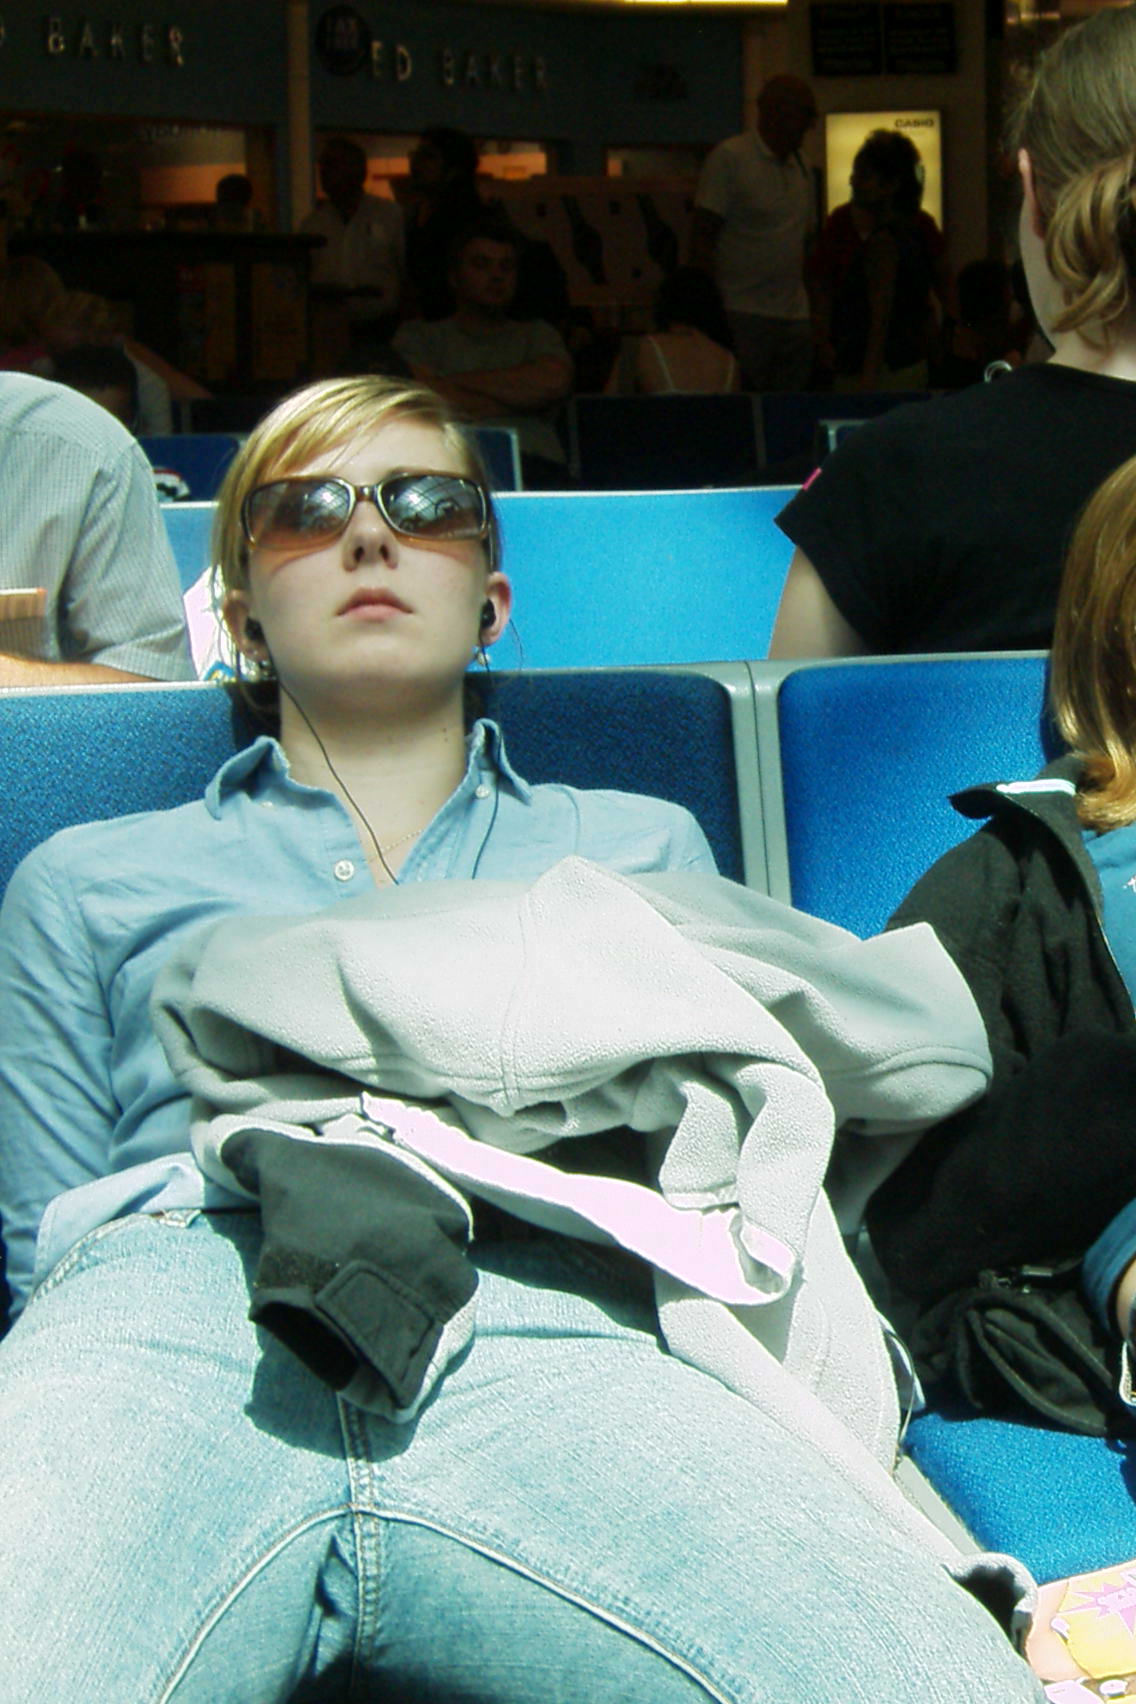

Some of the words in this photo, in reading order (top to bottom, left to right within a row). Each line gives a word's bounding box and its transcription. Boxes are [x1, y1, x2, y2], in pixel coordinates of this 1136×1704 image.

[49, 17, 185, 67] BAKER
[371, 39, 413, 82] ED
[894, 118, 935, 128] CASIO
